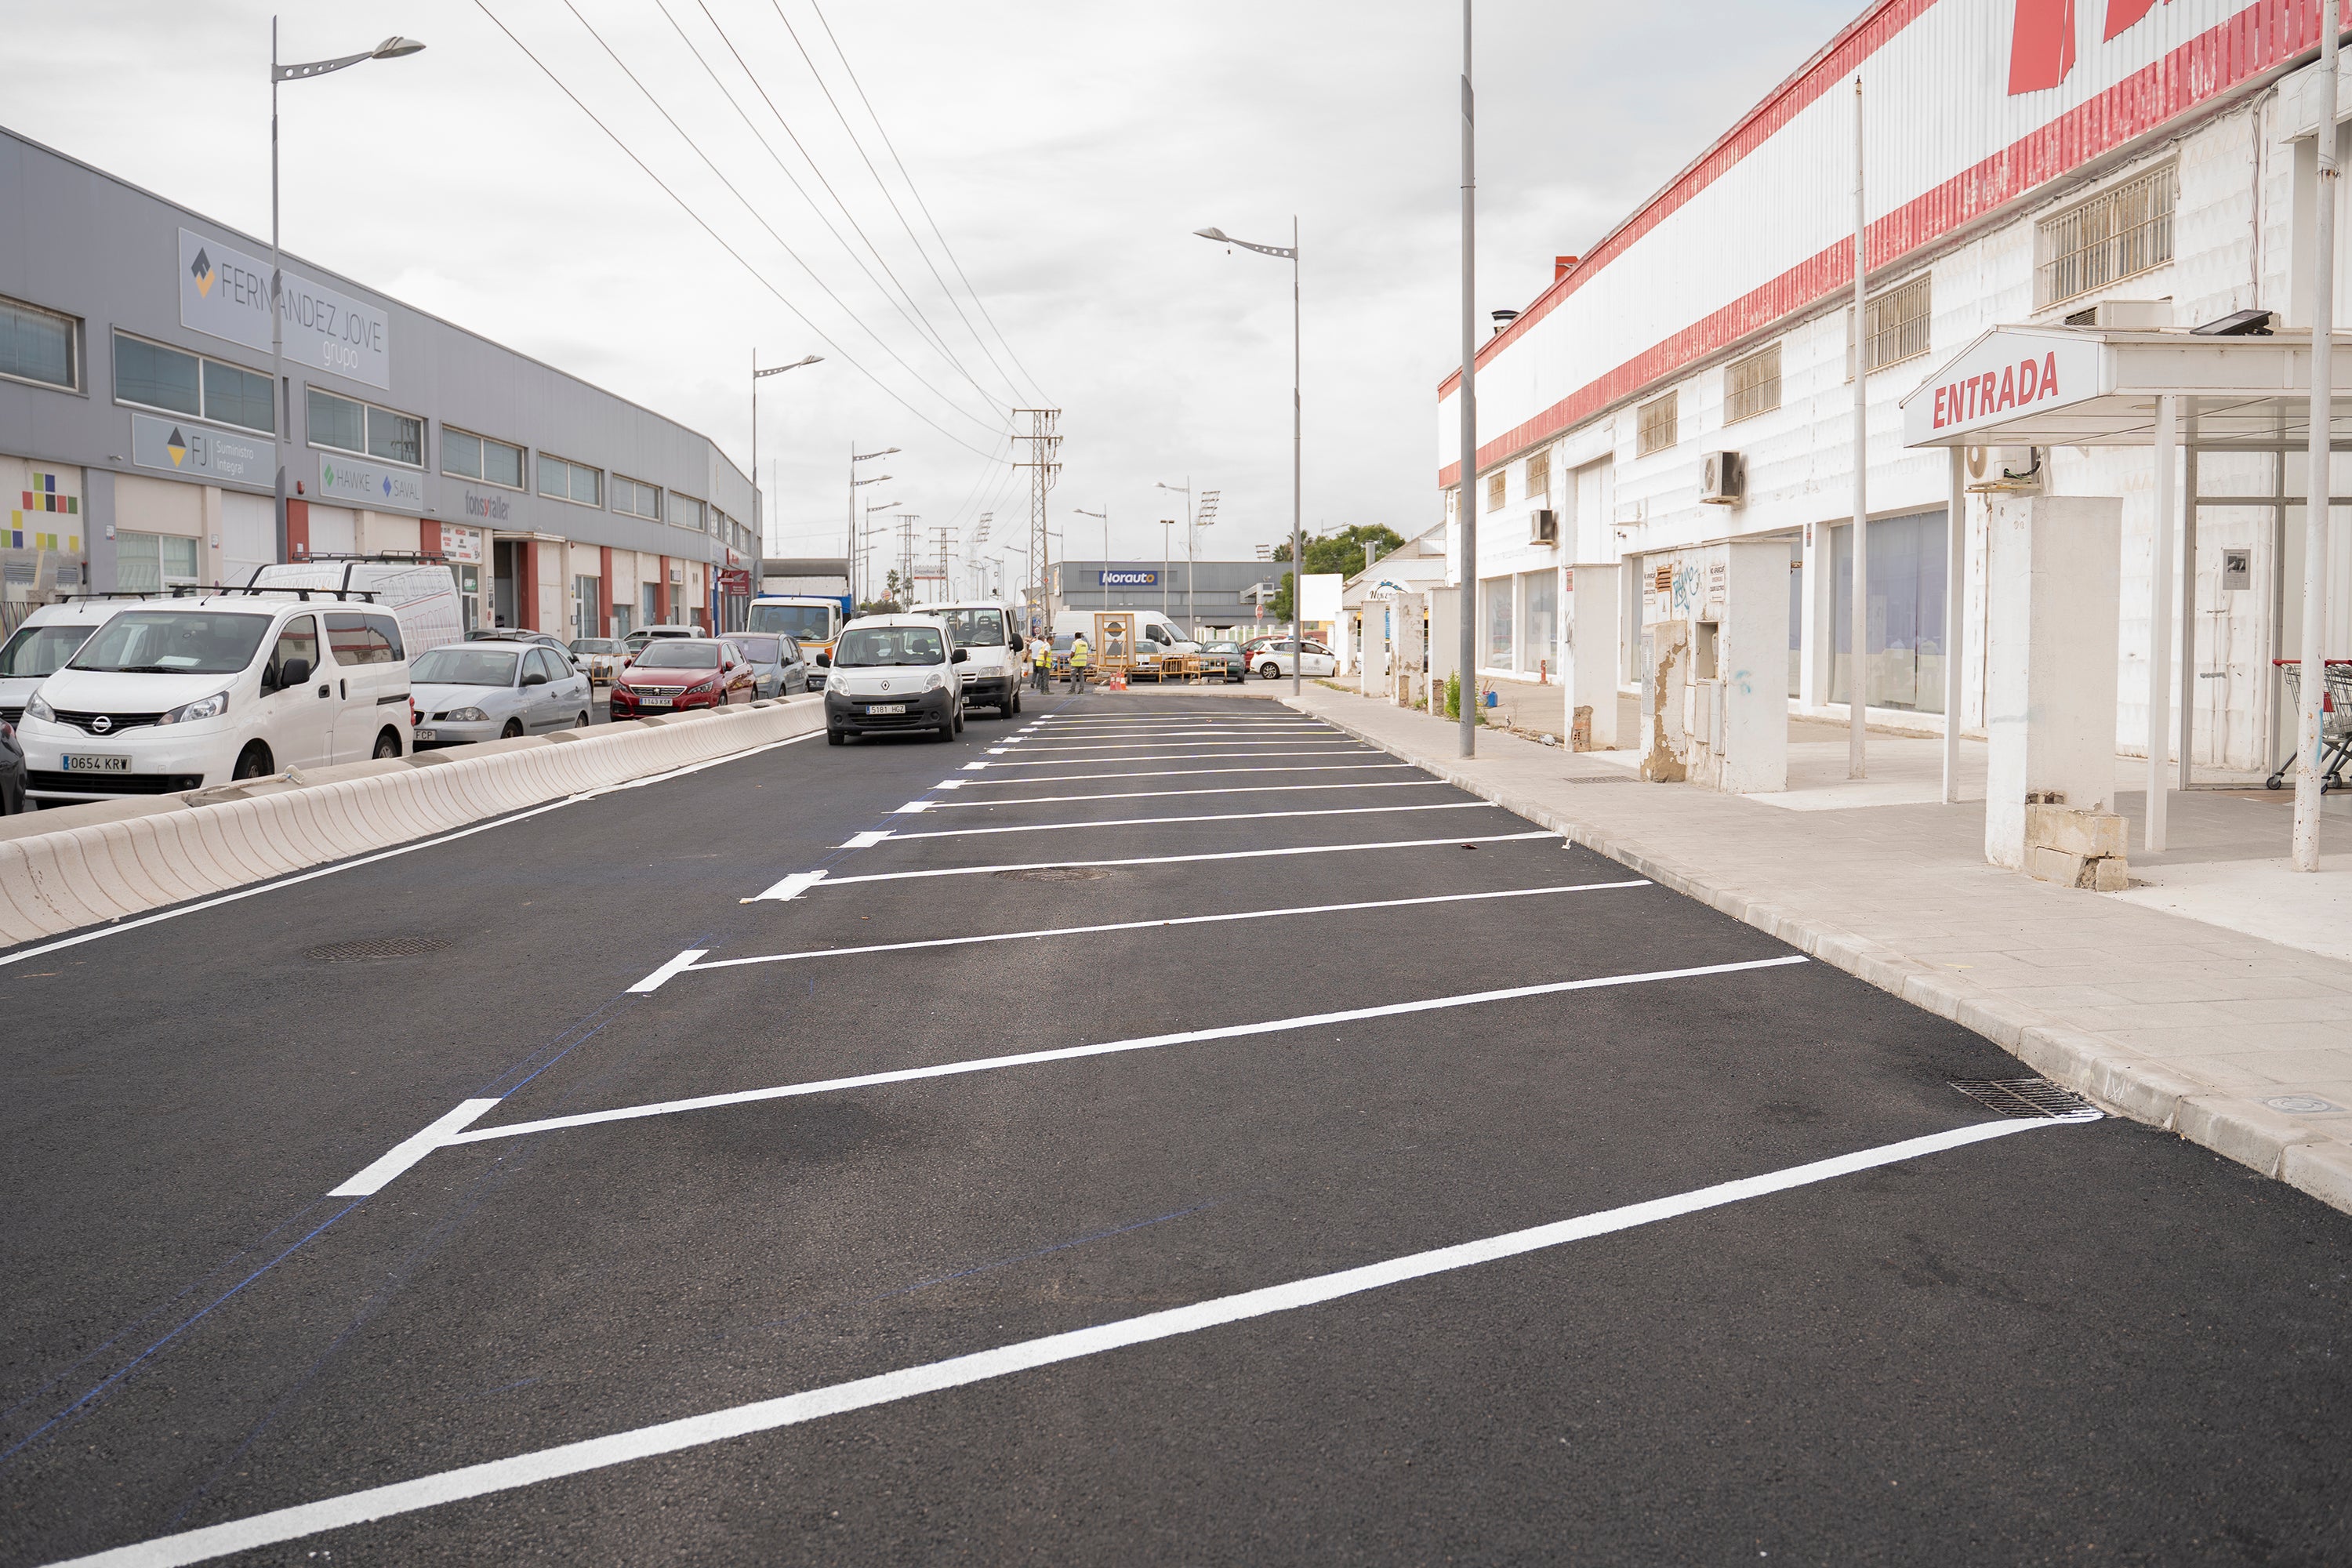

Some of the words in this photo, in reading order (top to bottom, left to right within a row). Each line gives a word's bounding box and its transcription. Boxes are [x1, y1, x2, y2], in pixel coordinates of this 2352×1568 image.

[342, 310, 382, 353] JOVE
[322, 340, 358, 371] grupo
[1933, 350, 2059, 430] ENTRADA
[192, 436, 208, 466] FJ
[216, 440, 254, 460] Suministro
[216, 458, 245, 476] Integral
[337, 468, 371, 492] HAWKE
[394, 479, 420, 501] SAVAL
[465, 488, 510, 521] fonsytaller
[1102, 572, 1155, 583] Norauto
[416, 731, 433, 740] FCP
[71, 757, 100, 769] 0654
[105, 758, 127, 770] KRW
